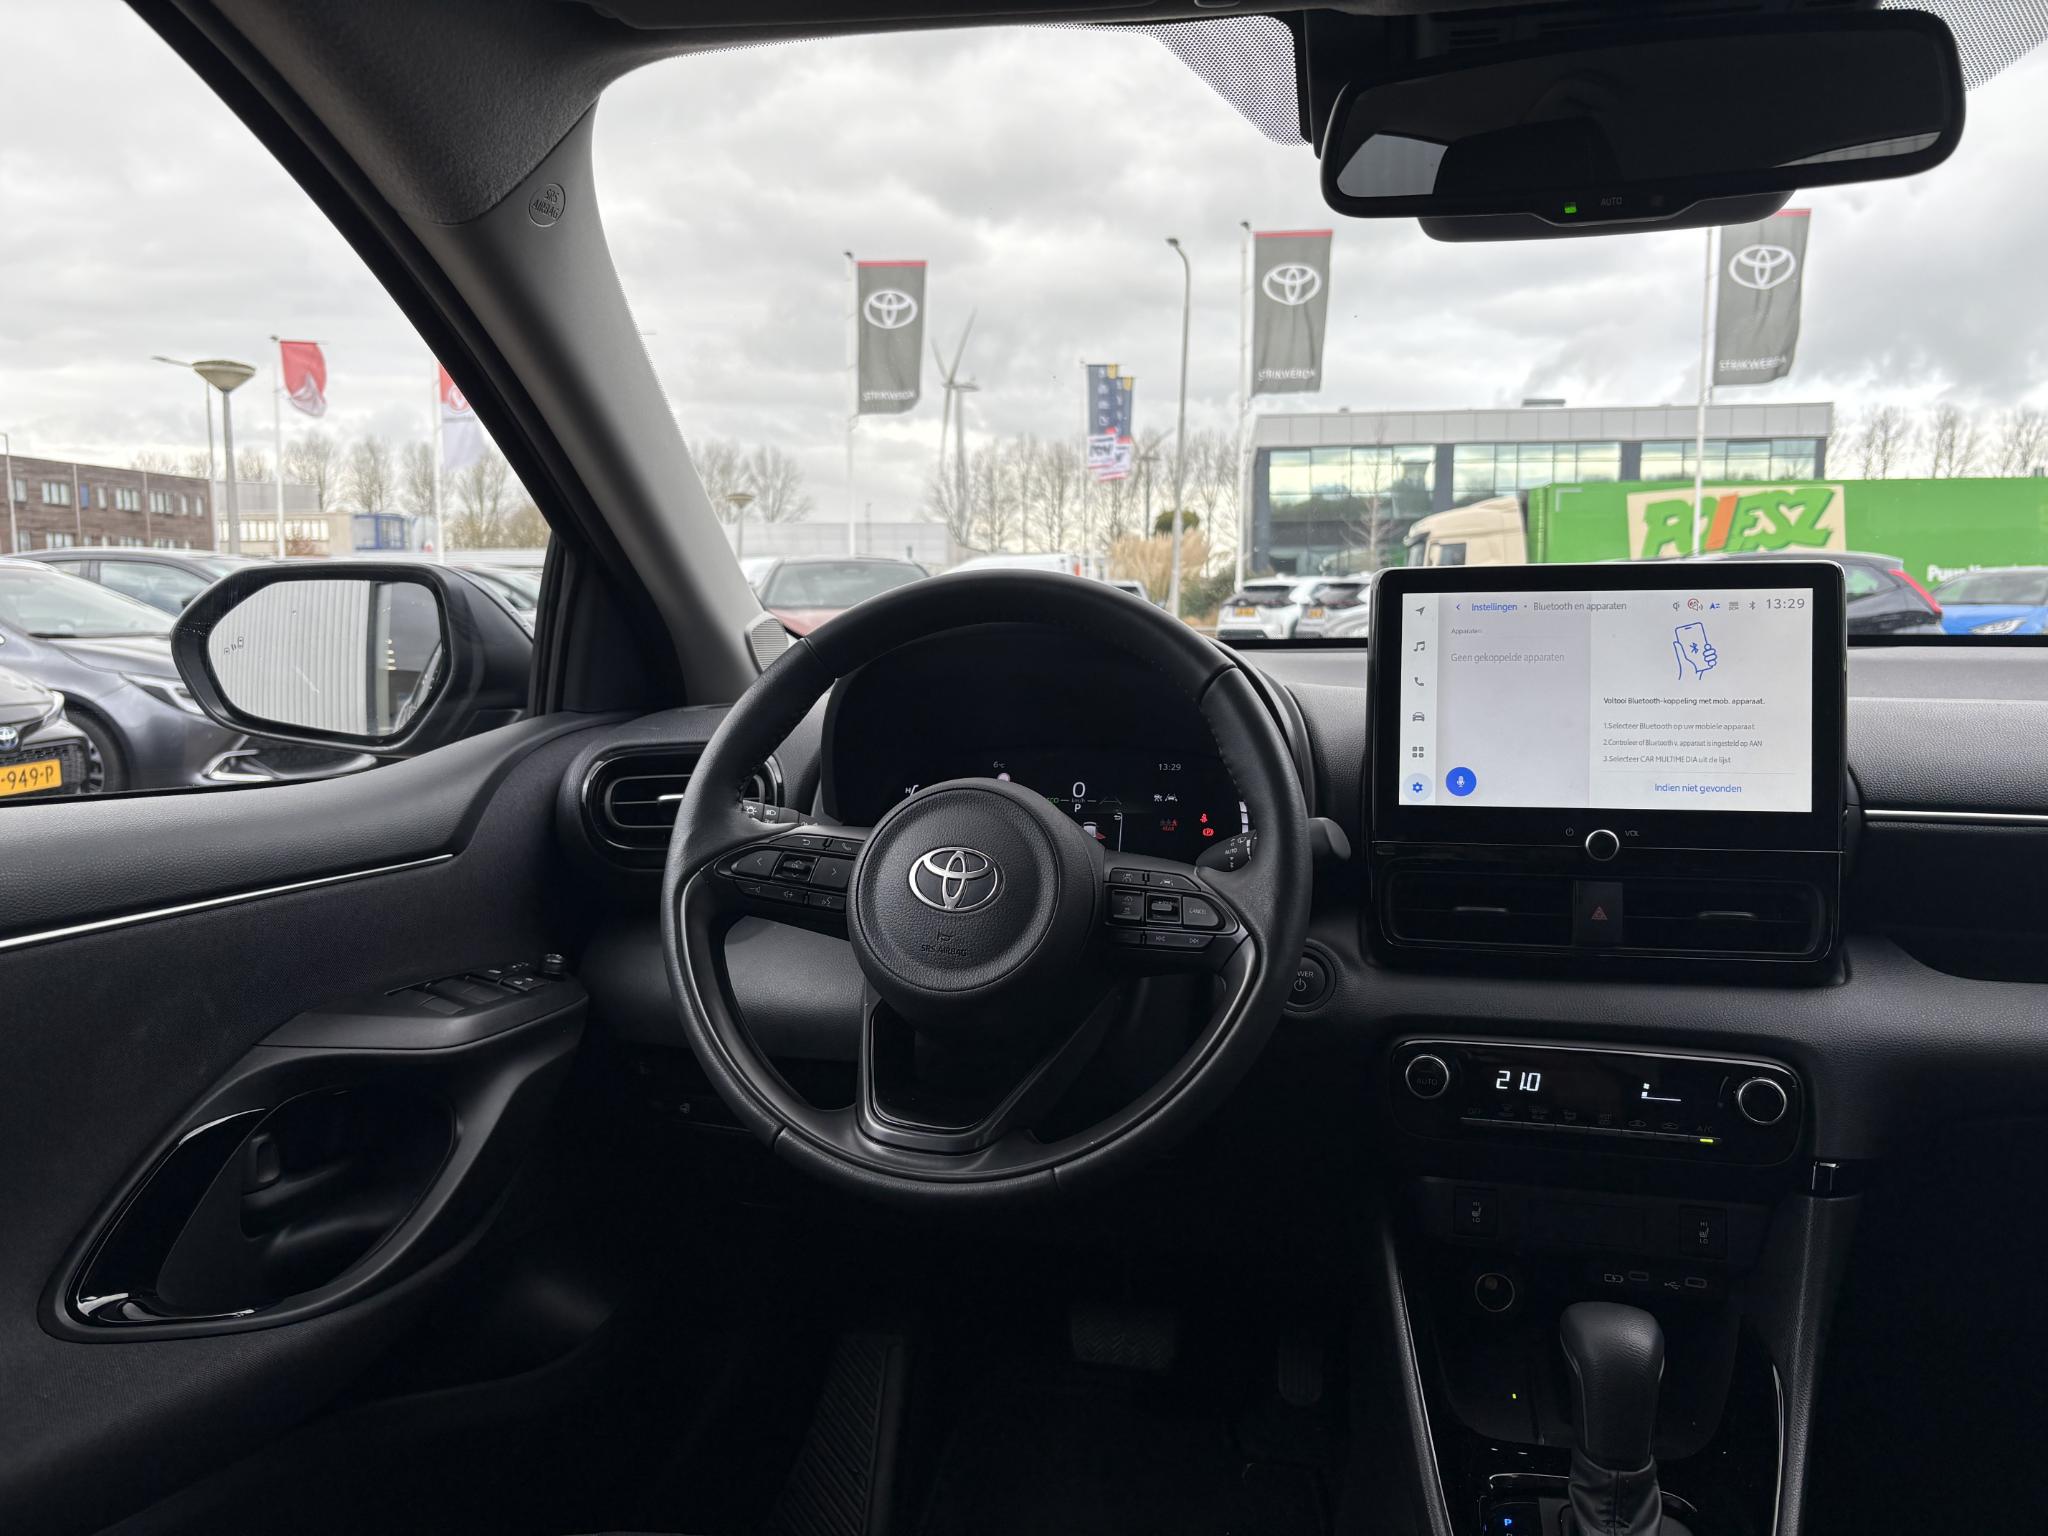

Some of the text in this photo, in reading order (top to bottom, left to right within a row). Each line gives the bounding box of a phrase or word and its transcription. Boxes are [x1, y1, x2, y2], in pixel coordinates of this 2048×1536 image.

[545, 188, 560, 203] SRS
[1600, 196, 1623, 206] AUTO
[531, 200, 560, 219] AIRBAG
[1471, 602, 1518, 615] Instellingen
[1533, 602, 1573, 611] Bluetooth
[1586, 602, 1627, 614] apparaten
[1766, 598, 1805, 609] 13:29
[1450, 652, 1565, 664] Geen gekoppelde apparaten
[1603, 697, 1627, 705] Voltooi
[1628, 697, 1697, 706] Bluetooth-koppeling
[1712, 697, 1731, 705] mob.
[1159, 763, 1182, 771] 13:29
[1072, 781, 1086, 798] 0
[1654, 784, 1742, 794] Indien niet gevonden
[1074, 803, 1082, 813] P
[1224, 847, 1238, 855] AUTO
[1297, 970, 1314, 978] WER
[1416, 1078, 1438, 1088] AUTO
[1503, 1518, 1513, 1527] P
